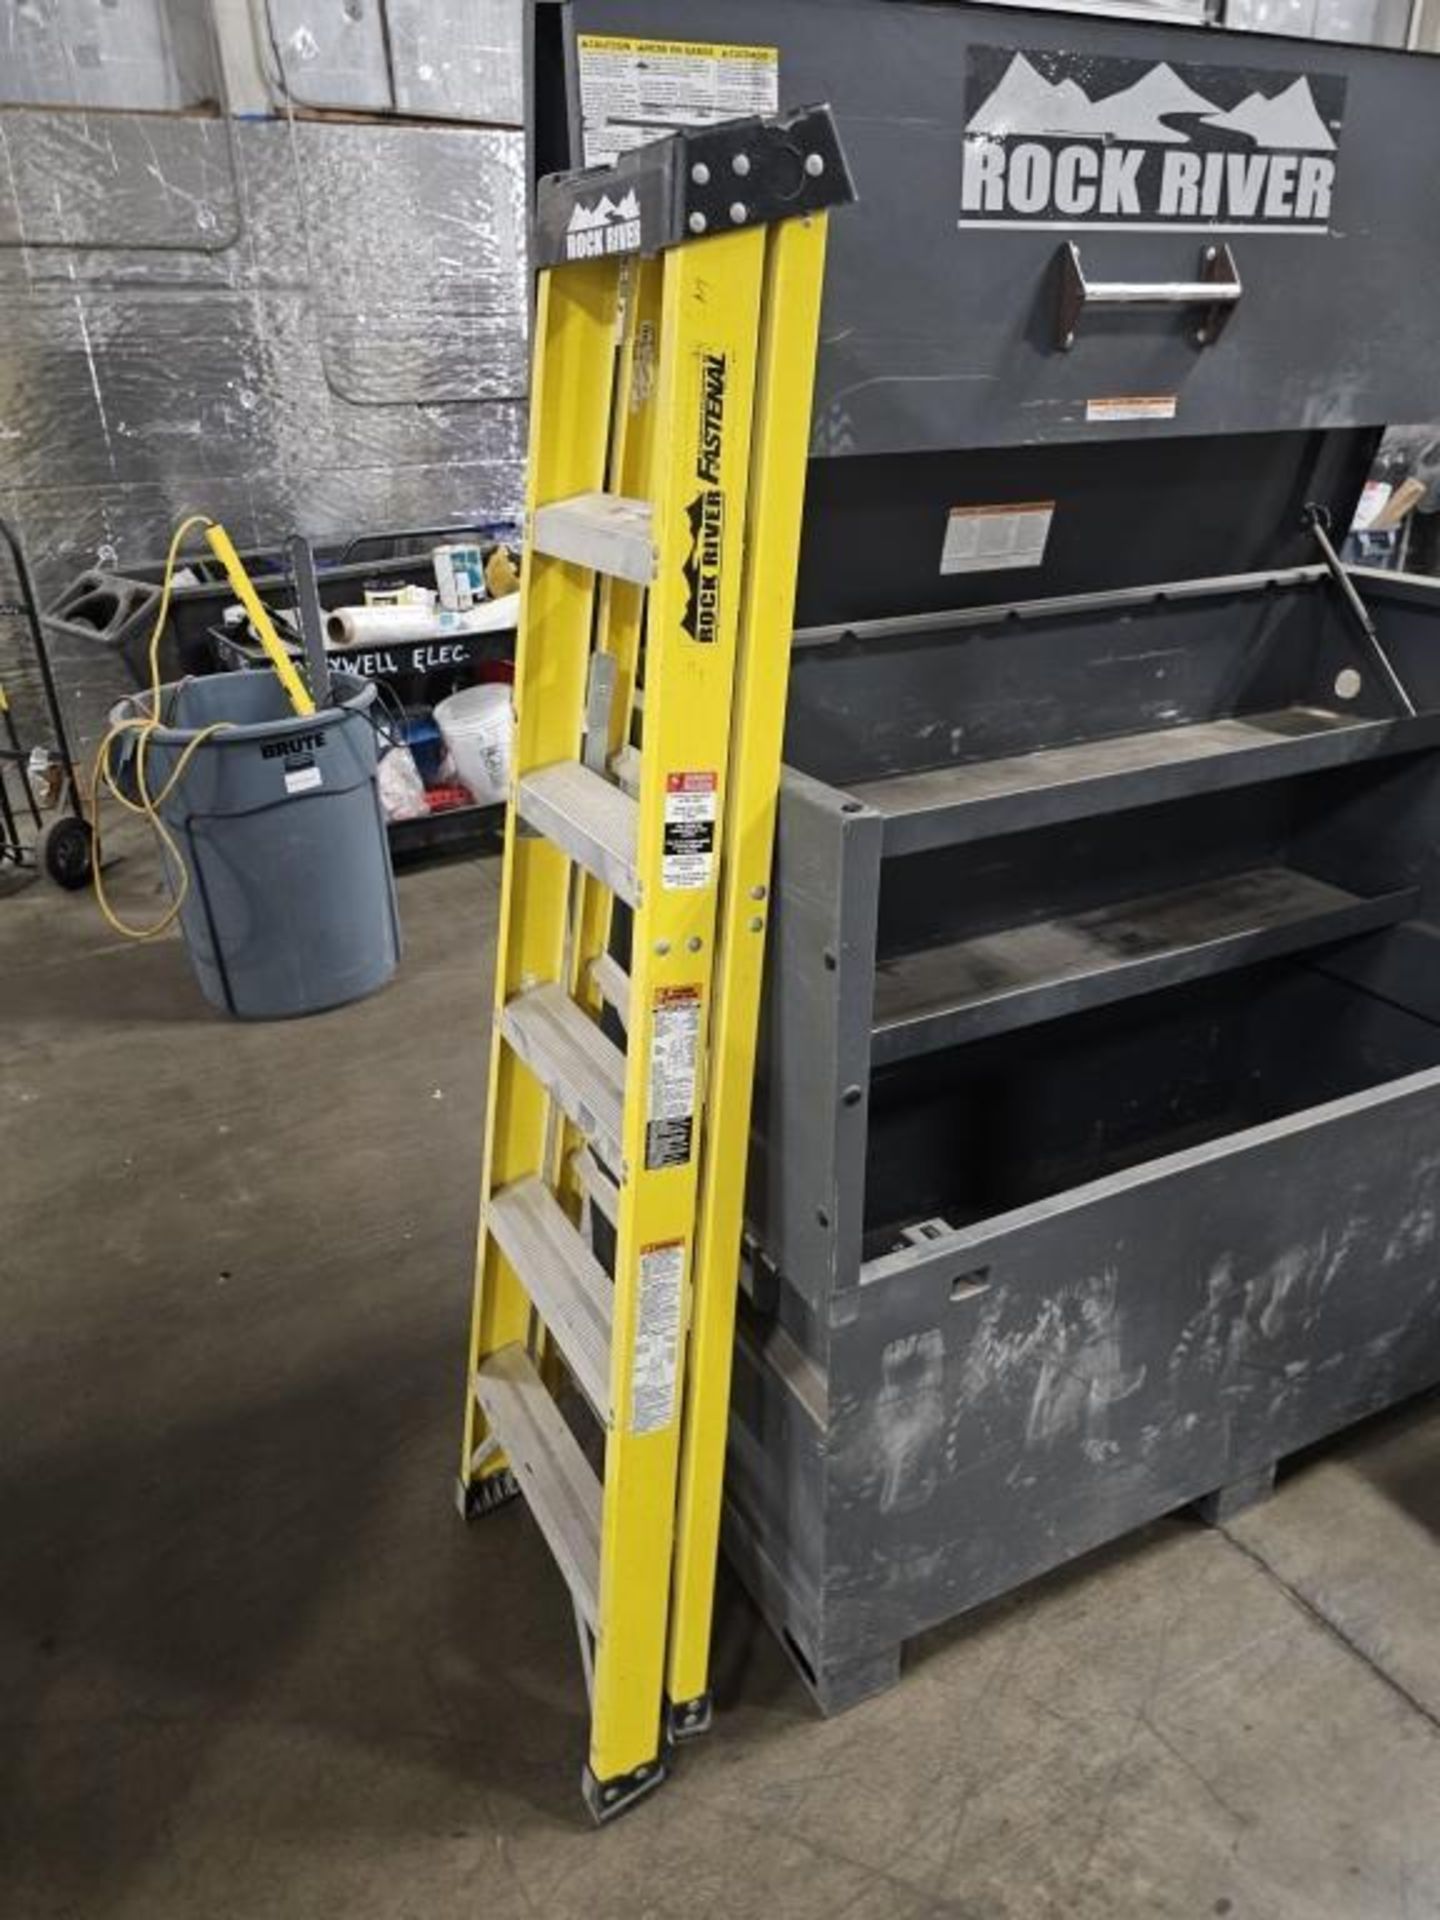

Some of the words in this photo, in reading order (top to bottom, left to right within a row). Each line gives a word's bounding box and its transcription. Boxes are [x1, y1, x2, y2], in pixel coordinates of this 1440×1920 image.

[961, 139, 1146, 215] ROCK
[1158, 150, 1336, 219] RIVER
[567, 229, 604, 260] ROCK
[605, 219, 641, 255] RIVER
[696, 353, 727, 485] FASTENAL
[701, 490, 721, 567] RIVER
[698, 572, 718, 643] ROCK
[261, 732, 326, 759] BRUTE
